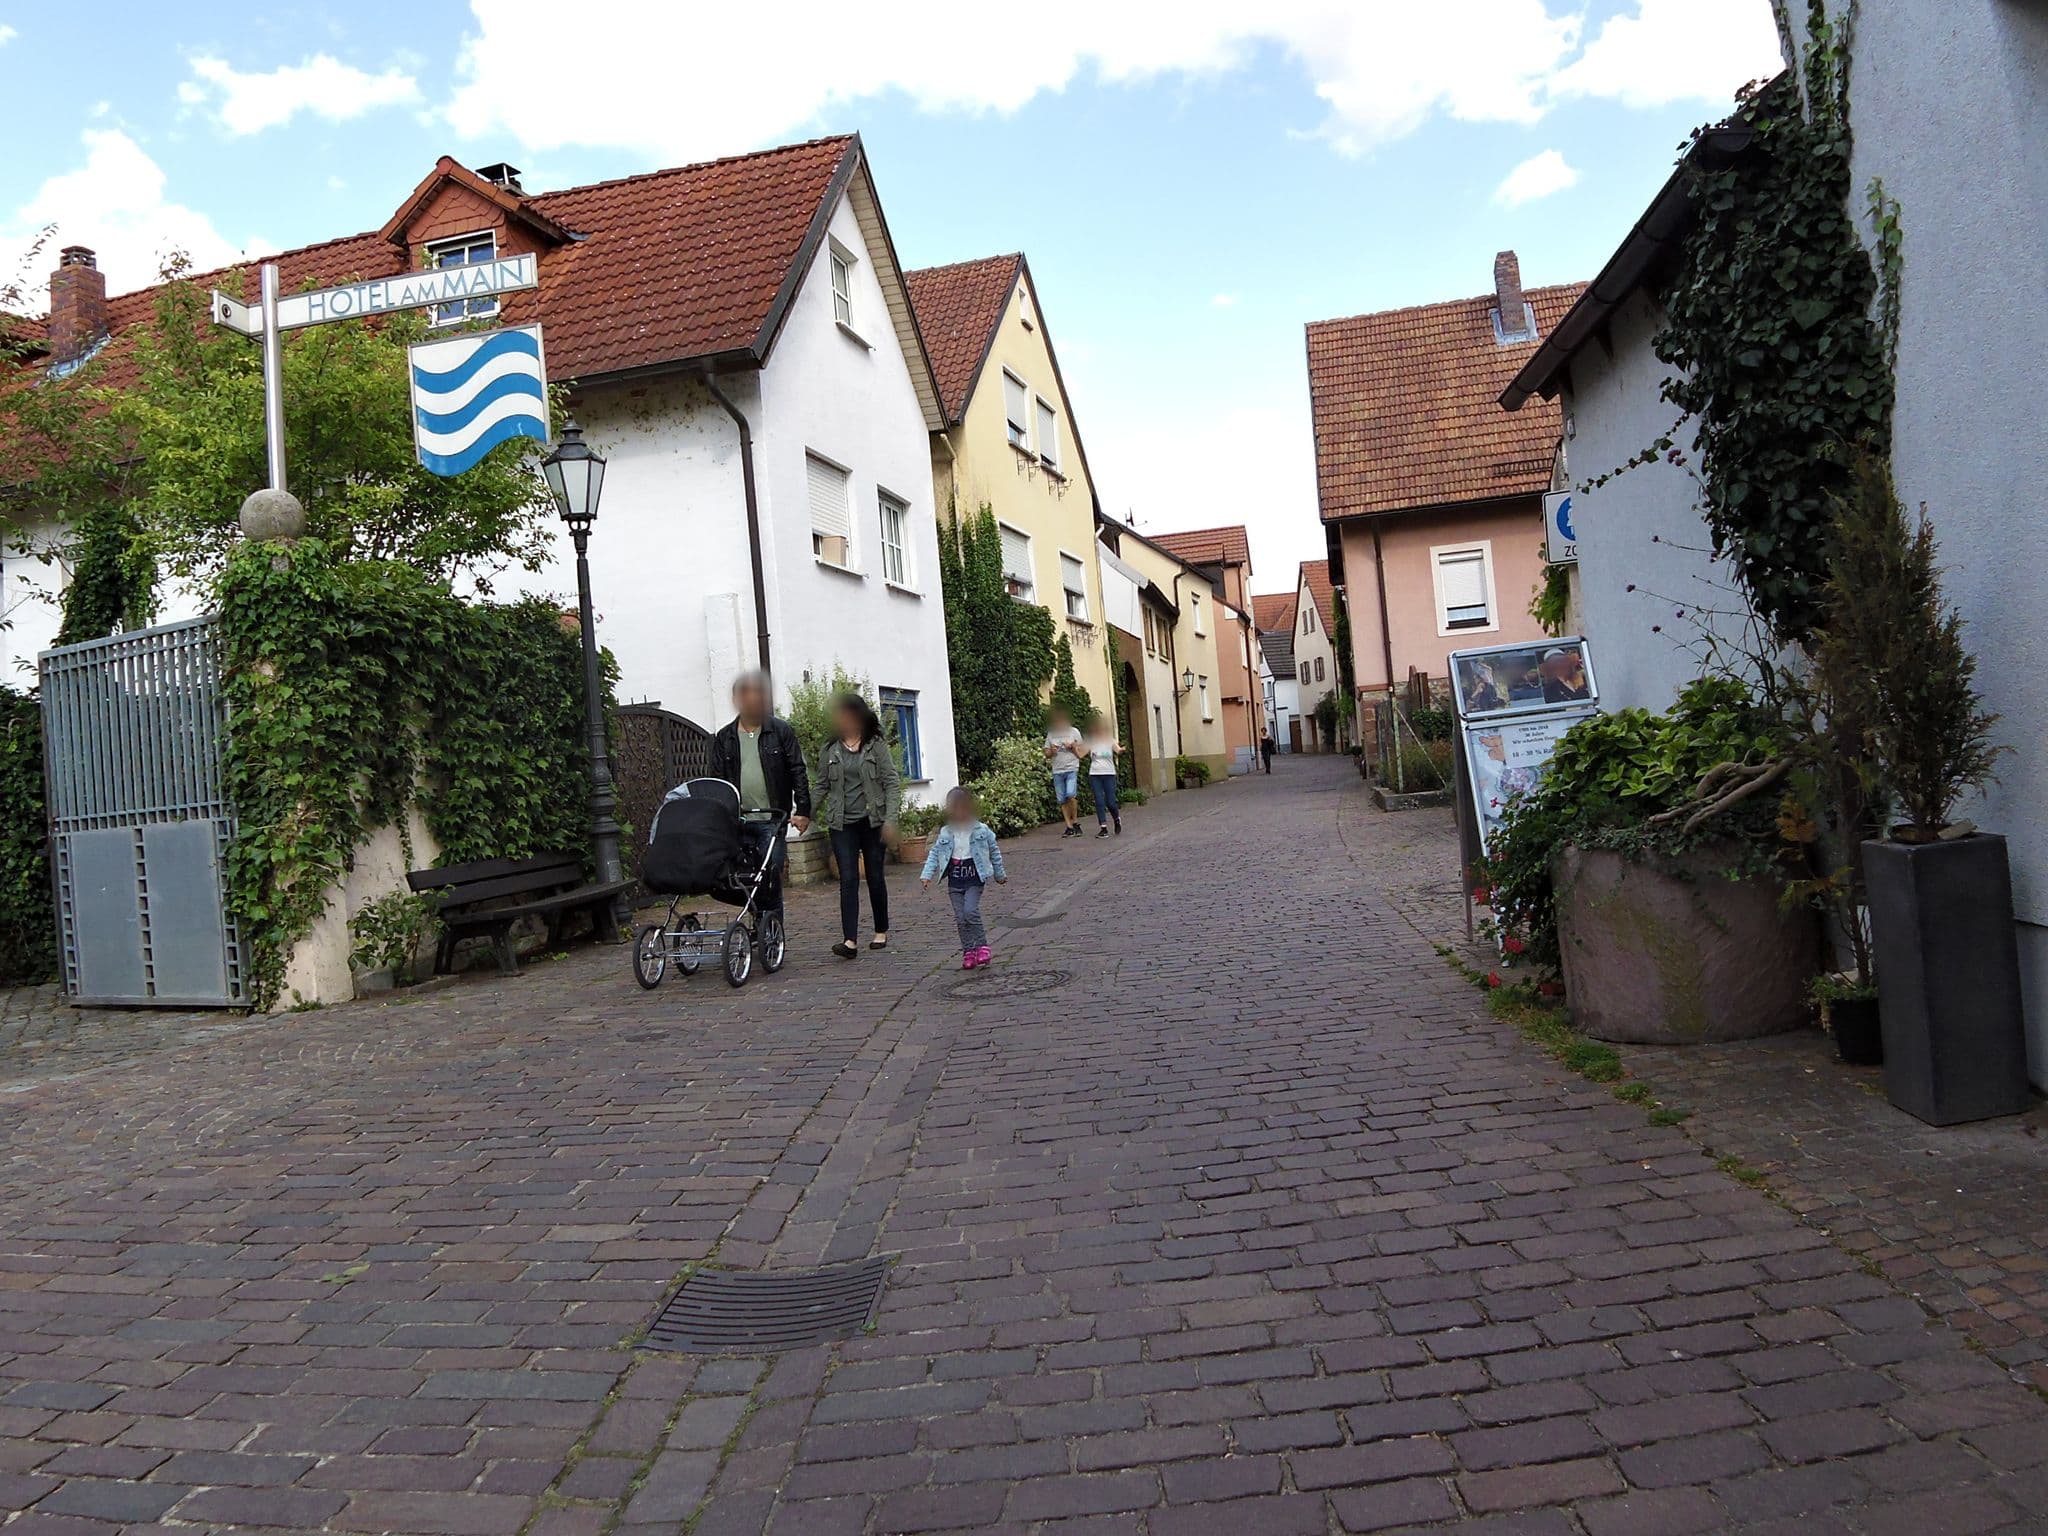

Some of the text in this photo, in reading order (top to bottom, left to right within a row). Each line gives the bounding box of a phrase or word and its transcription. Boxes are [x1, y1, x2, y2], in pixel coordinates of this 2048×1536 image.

[308, 258, 523, 322] HOTEL AM MAIN
